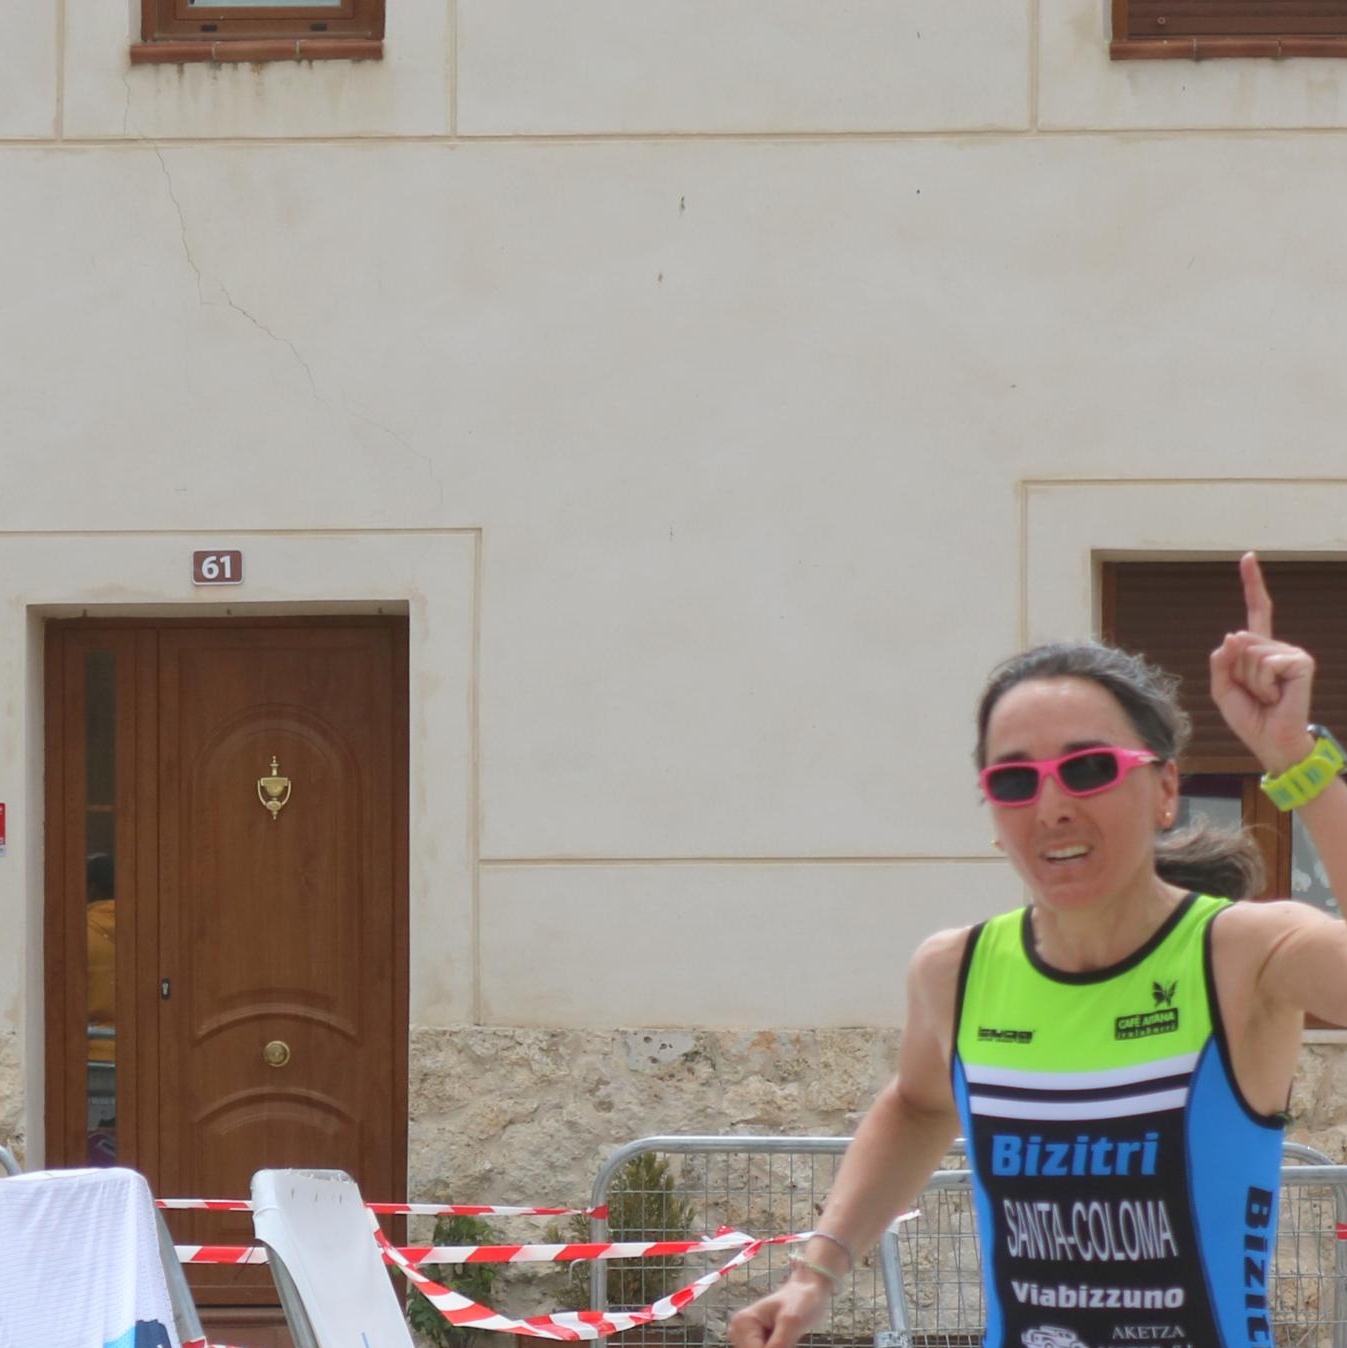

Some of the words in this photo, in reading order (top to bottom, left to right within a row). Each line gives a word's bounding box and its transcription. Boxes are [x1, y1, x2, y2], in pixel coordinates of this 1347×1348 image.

[202, 555, 231, 579] 61
[991, 1132, 1159, 1176] Bizitri
[1003, 1199, 1179, 1261] SANTA-COLOMA
[1011, 1280, 1184, 1308] Viabizzuno
[1112, 1325, 1185, 1339] AKETZA
